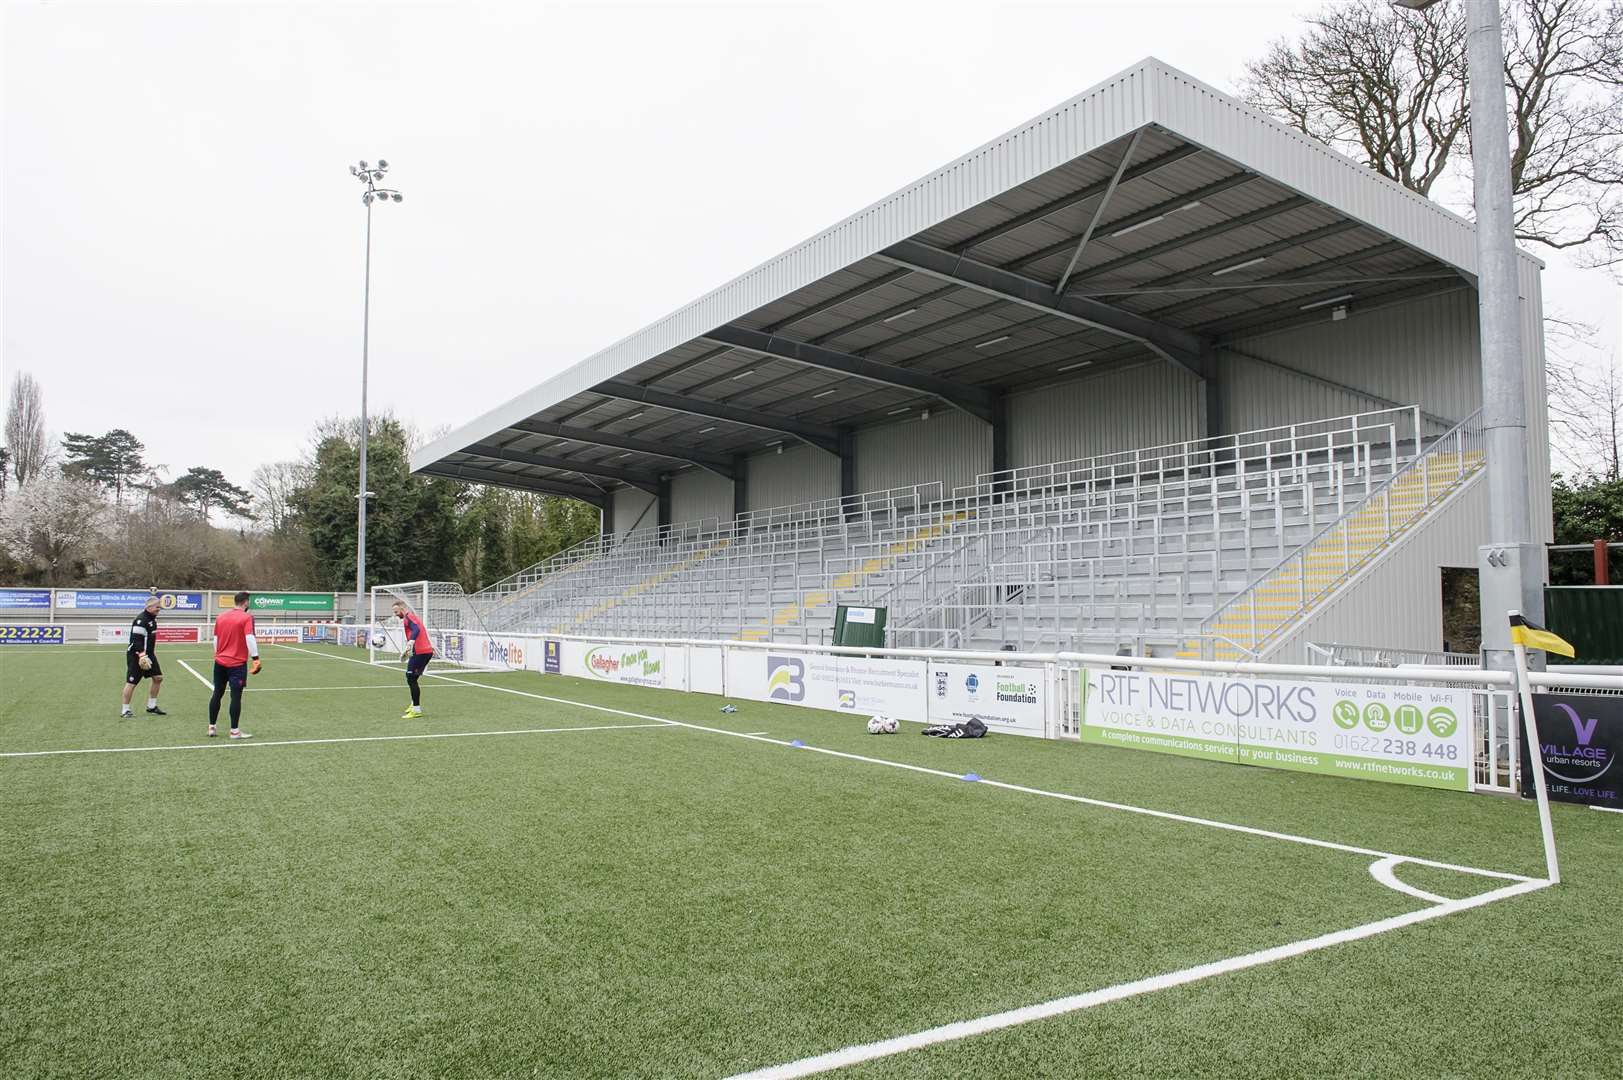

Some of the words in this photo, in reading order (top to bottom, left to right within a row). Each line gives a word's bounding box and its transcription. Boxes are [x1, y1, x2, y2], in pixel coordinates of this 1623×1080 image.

[489, 641, 523, 664] Britelite
[592, 654, 619, 674] Gallagher
[997, 682, 1025, 693] Football
[1335, 688, 1357, 698] Voice
[1367, 690, 1386, 700] Data
[1394, 692, 1423, 702] Mobile
[1430, 694, 1453, 703] Wi-Fi
[997, 692, 1036, 704] Foundation
[1101, 674, 1140, 705] RTF
[1149, 677, 1317, 723] NETWORKS
[1102, 711, 1141, 727] VOICE
[1146, 715, 1154, 728] &
[1161, 717, 1195, 733] DATA
[1202, 721, 1318, 746] CONSULTANTS
[1102, 730, 1108, 738] A
[1109, 732, 1140, 744] complete
[1142, 735, 1202, 751] communications
[1204, 744, 1234, 755] service
[1236, 746, 1250, 757] for
[1252, 751, 1274, 763] your
[1276, 752, 1319, 766] business
[1334, 734, 1380, 752] 01622
[1384, 739, 1416, 756] 238
[1422, 743, 1457, 761] 448
[1540, 744, 1607, 760] VILLAGE
[1335, 758, 1455, 781] www.rtfnetworks.co.uk
[1547, 756, 1569, 765] urban
[1571, 758, 1601, 768] resorts
[1574, 787, 1595, 797] LOVE
